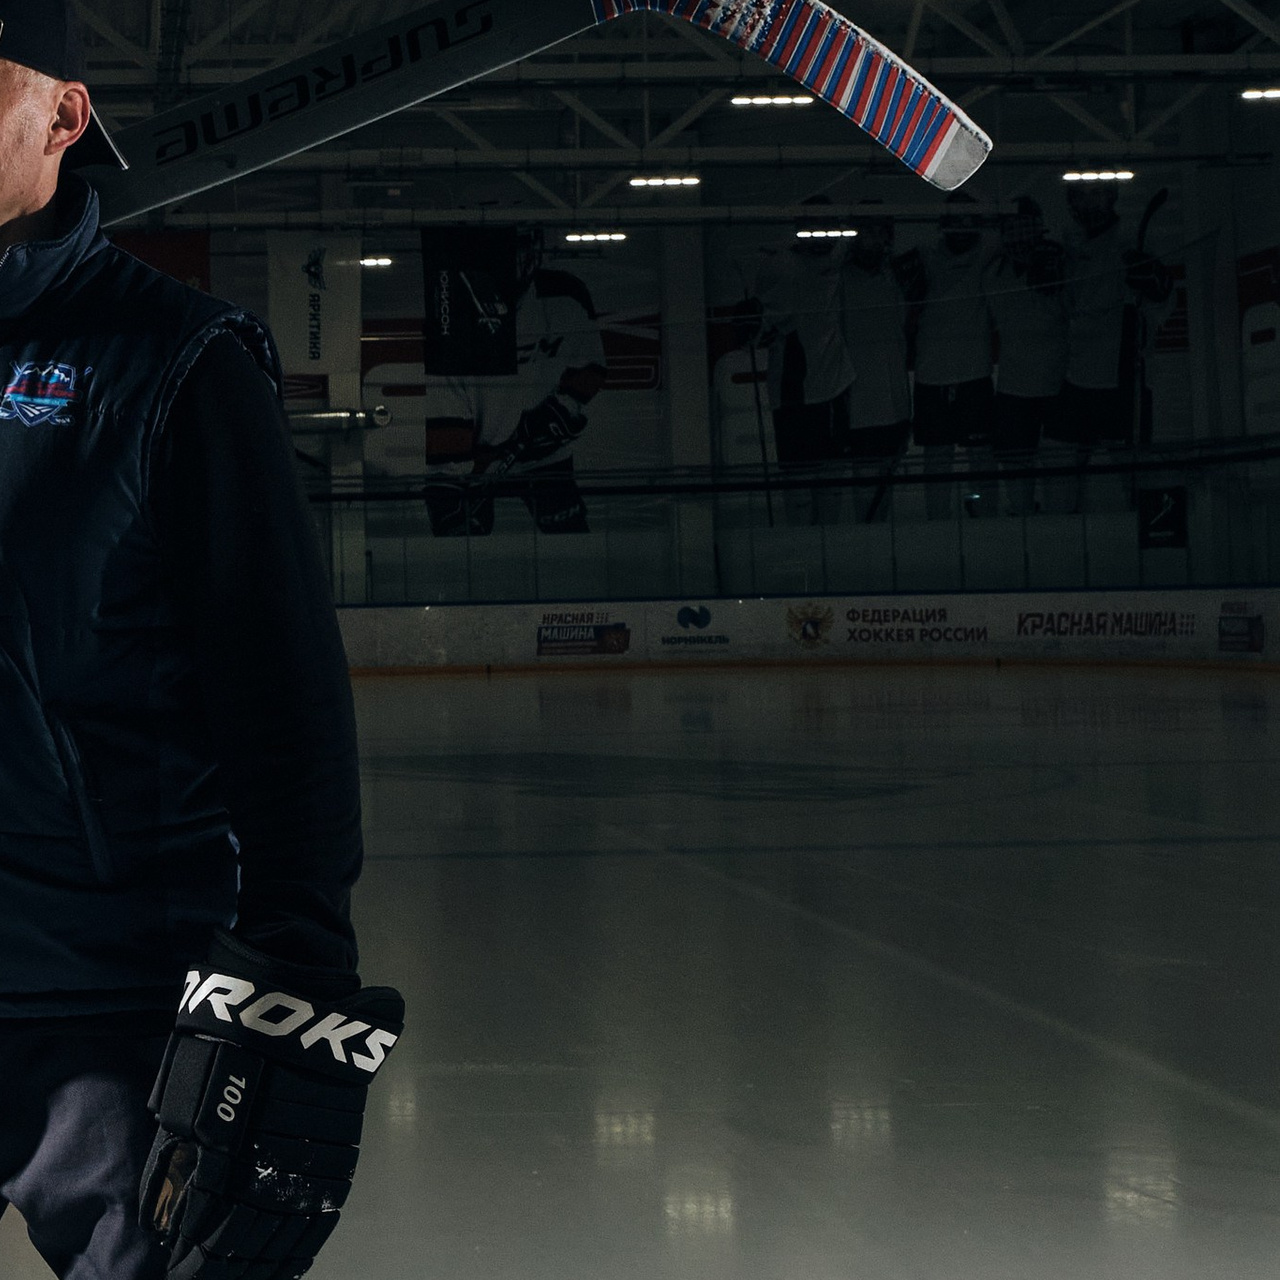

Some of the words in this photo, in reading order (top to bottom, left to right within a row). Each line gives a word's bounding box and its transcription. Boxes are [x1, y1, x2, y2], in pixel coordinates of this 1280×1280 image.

[439, 270, 451, 336] ЮНИСОН
[308, 293, 321, 360] АРКТИКА
[542, 612, 594, 625] КРАСНАЯ
[846, 607, 948, 624] ФЕДЕРАЦИЯ
[1017, 612, 1108, 635] КРАСНАЯ
[1110, 612, 1177, 635] МАШИНА
[540, 626, 596, 640] МАШИНА
[661, 635, 729, 645] НОРНИКЕЛЬ
[847, 627, 915, 641] ХОККЕЯ
[919, 627, 988, 641] РОССИИ
[216, 1073, 246, 1123] 100
